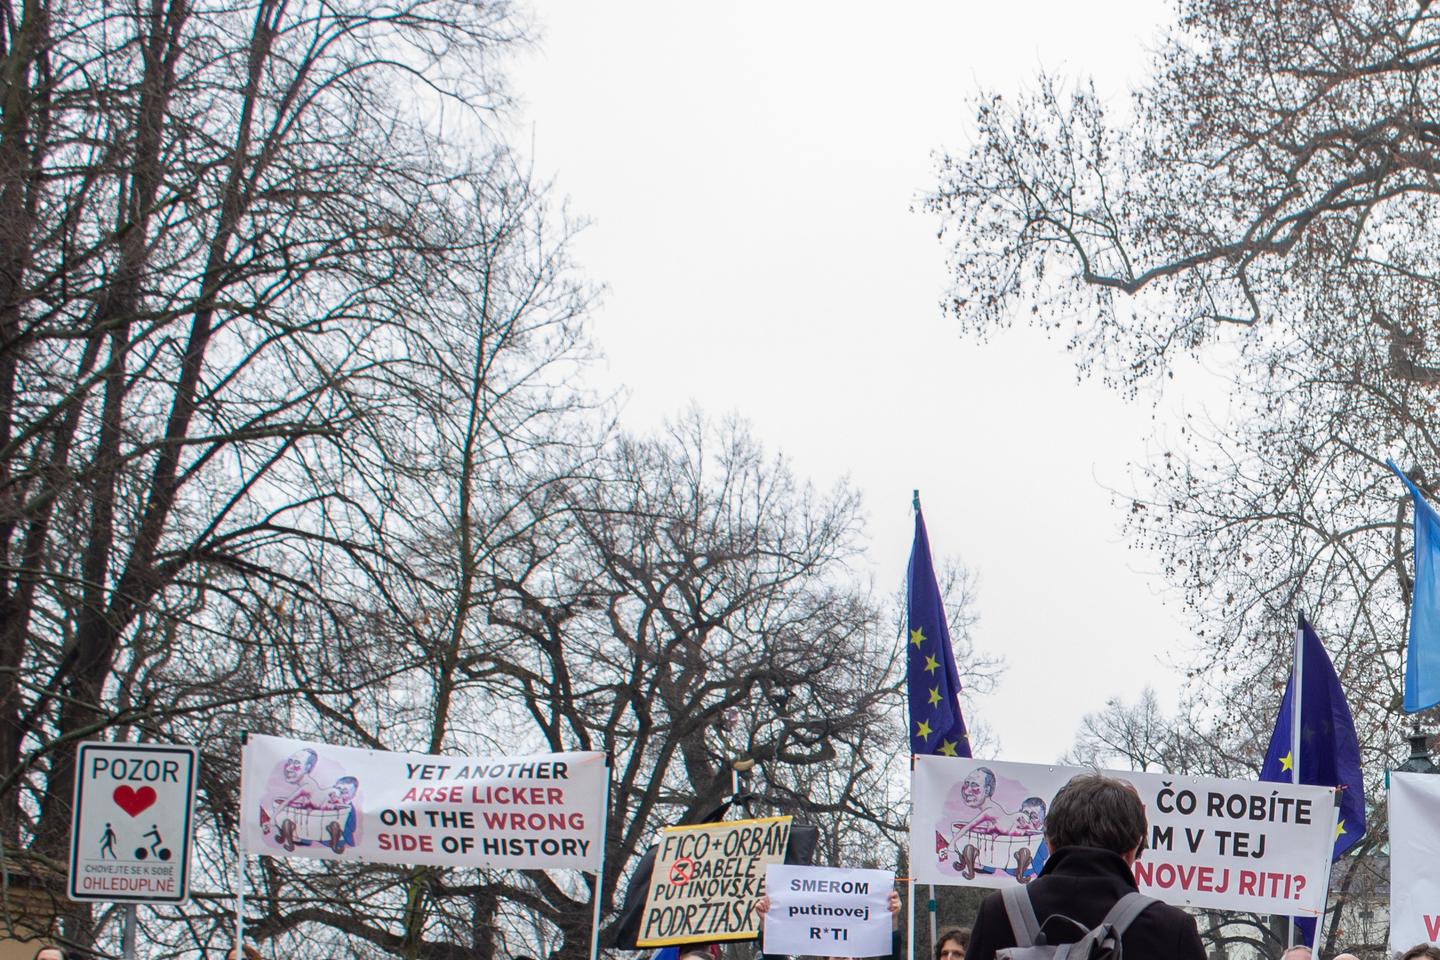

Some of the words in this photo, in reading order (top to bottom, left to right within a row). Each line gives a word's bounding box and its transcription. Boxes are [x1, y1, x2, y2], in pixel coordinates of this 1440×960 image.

[92, 757, 179, 783] POZOR
[406, 763, 450, 781] YET
[454, 761, 569, 780] ANOTHER
[402, 786, 464, 803] ARSE
[471, 786, 564, 805] LICKER
[1156, 781, 1197, 815] ČO
[1207, 790, 1312, 825] ROBÍTE
[380, 809, 417, 827] ON
[425, 810, 475, 829] THE
[483, 812, 585, 831] WRONG
[377, 833, 433, 852] SIDE
[441, 836, 474, 854] OF
[483, 838, 590, 857] HISTORY
[661, 832, 711, 861] FICO
[723, 821, 789, 858] ORBÁN
[1185, 827, 1205, 853] V
[1214, 830, 1266, 859] TEJ
[85, 864, 129, 875] CHOVEJTE
[131, 865, 142, 875] SE
[143, 866, 149, 875] K
[151, 865, 174, 876] SOBĚ
[83, 876, 175, 892] OHLEDUPLNĚ
[790, 879, 869, 894] SMEROM
[1238, 870, 1306, 900] RITI?
[645, 893, 761, 939] PODRŽTAŠK
[789, 904, 869, 920] putinovej
